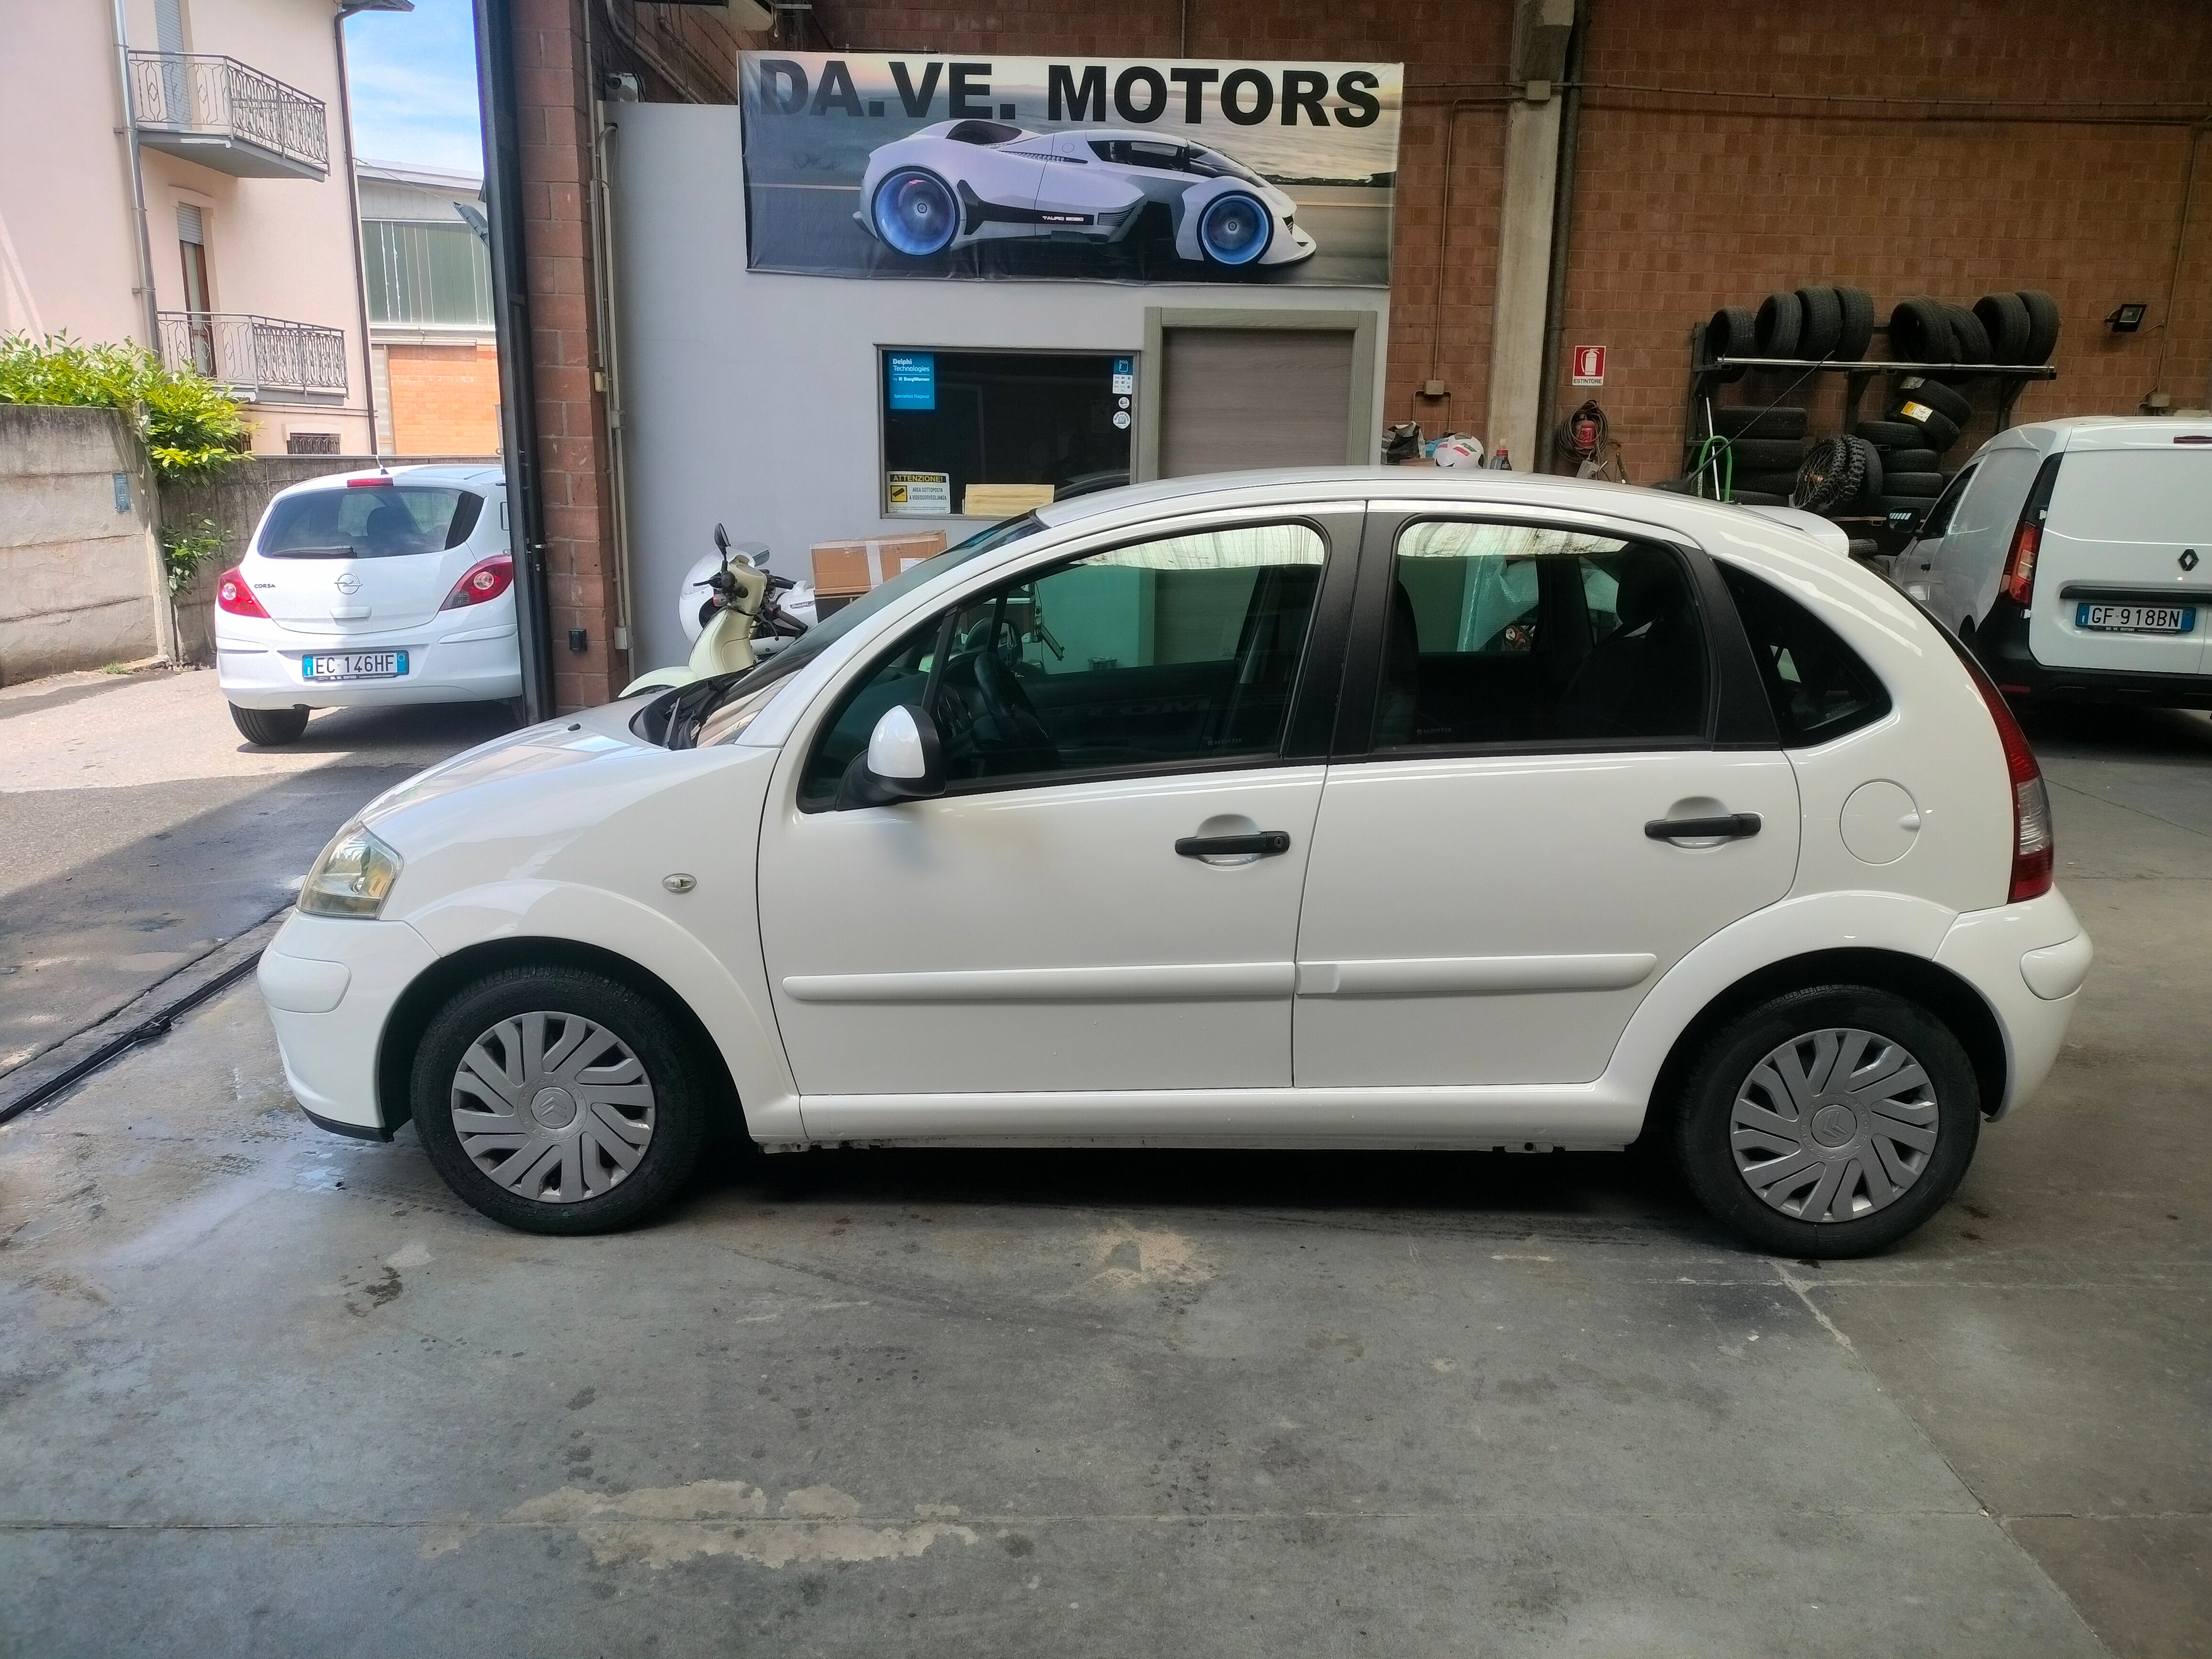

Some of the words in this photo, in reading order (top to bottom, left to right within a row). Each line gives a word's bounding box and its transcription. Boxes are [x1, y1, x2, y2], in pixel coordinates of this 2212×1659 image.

[760, 59, 1016, 120] DA.VE.
[1048, 65, 1380, 128] MOTORS
[2092, 607, 2114, 624] GF
[2120, 608, 2180, 627] 918BN
[316, 657, 335, 674] EC
[344, 654, 394, 673] 146HF
